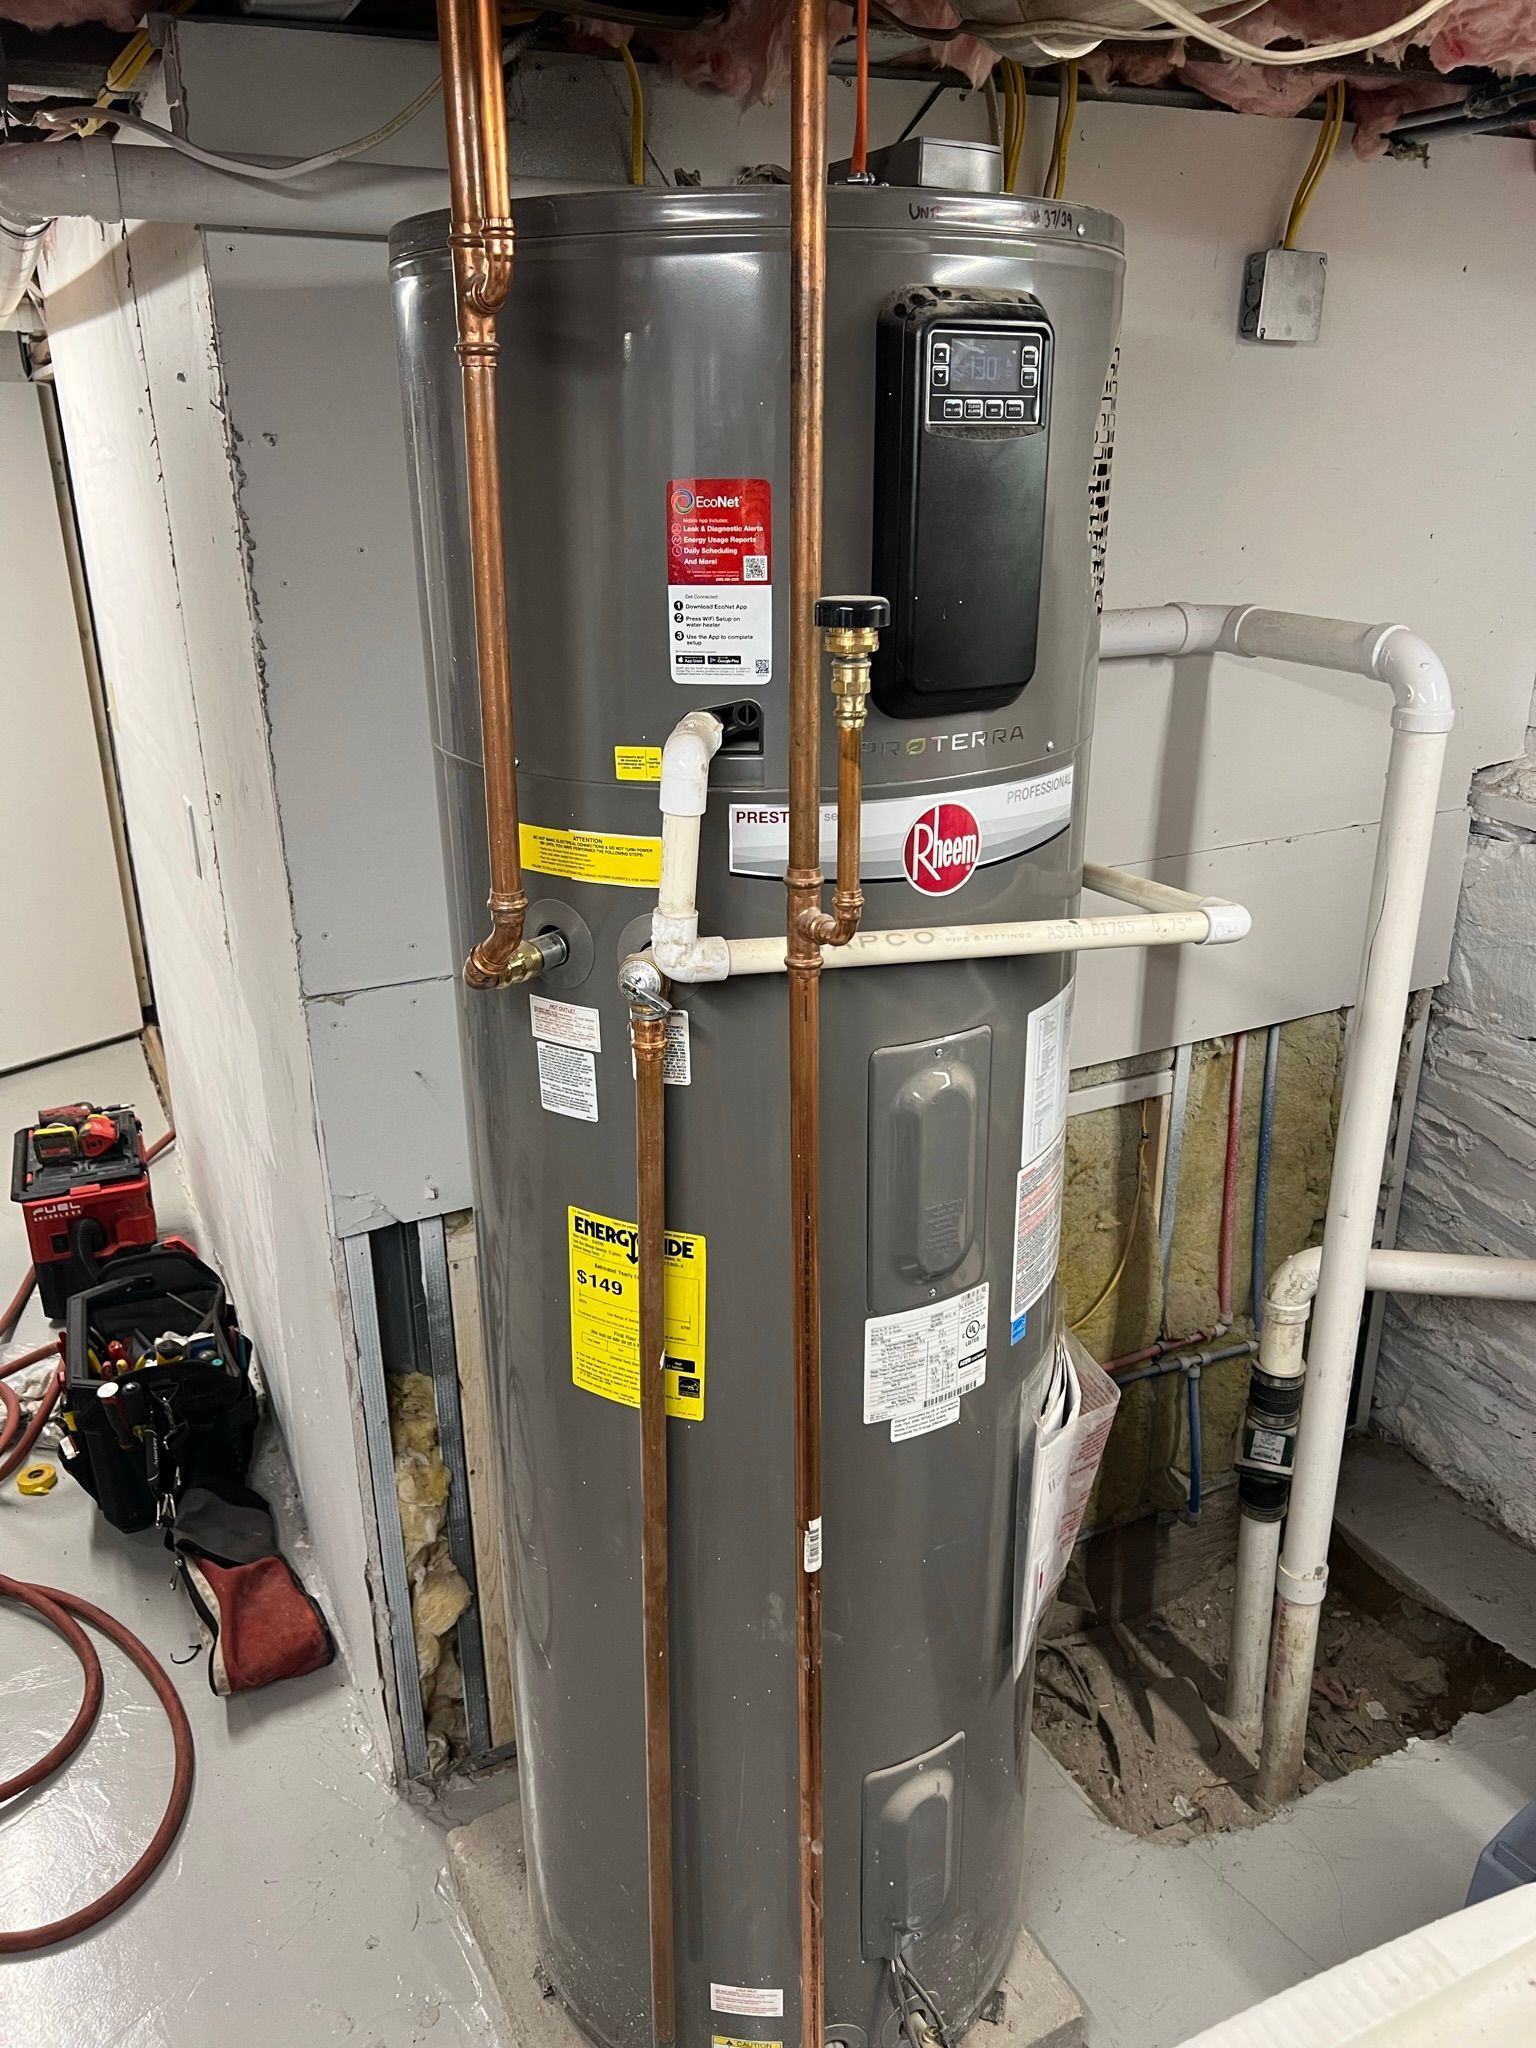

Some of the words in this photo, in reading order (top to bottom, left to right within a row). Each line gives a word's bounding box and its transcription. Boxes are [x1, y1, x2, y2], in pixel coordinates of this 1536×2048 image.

[696, 496, 740, 508] EcoNet
[1007, 773, 1072, 804] PROFESSIONAL
[736, 811, 790, 824] PREST
[573, 836, 602, 844] ATTENTION
[912, 806, 977, 882] Rheem
[1047, 924, 1084, 940] ASTM
[1092, 920, 1135, 937] D1785
[32, 1202, 80, 1216] FUEL
[574, 1215, 694, 1259] ENERGYIDE
[594, 1263, 616, 1274] Estimated
[577, 1269, 623, 1295] $149
[965, 1336, 979, 1347] LISTED
